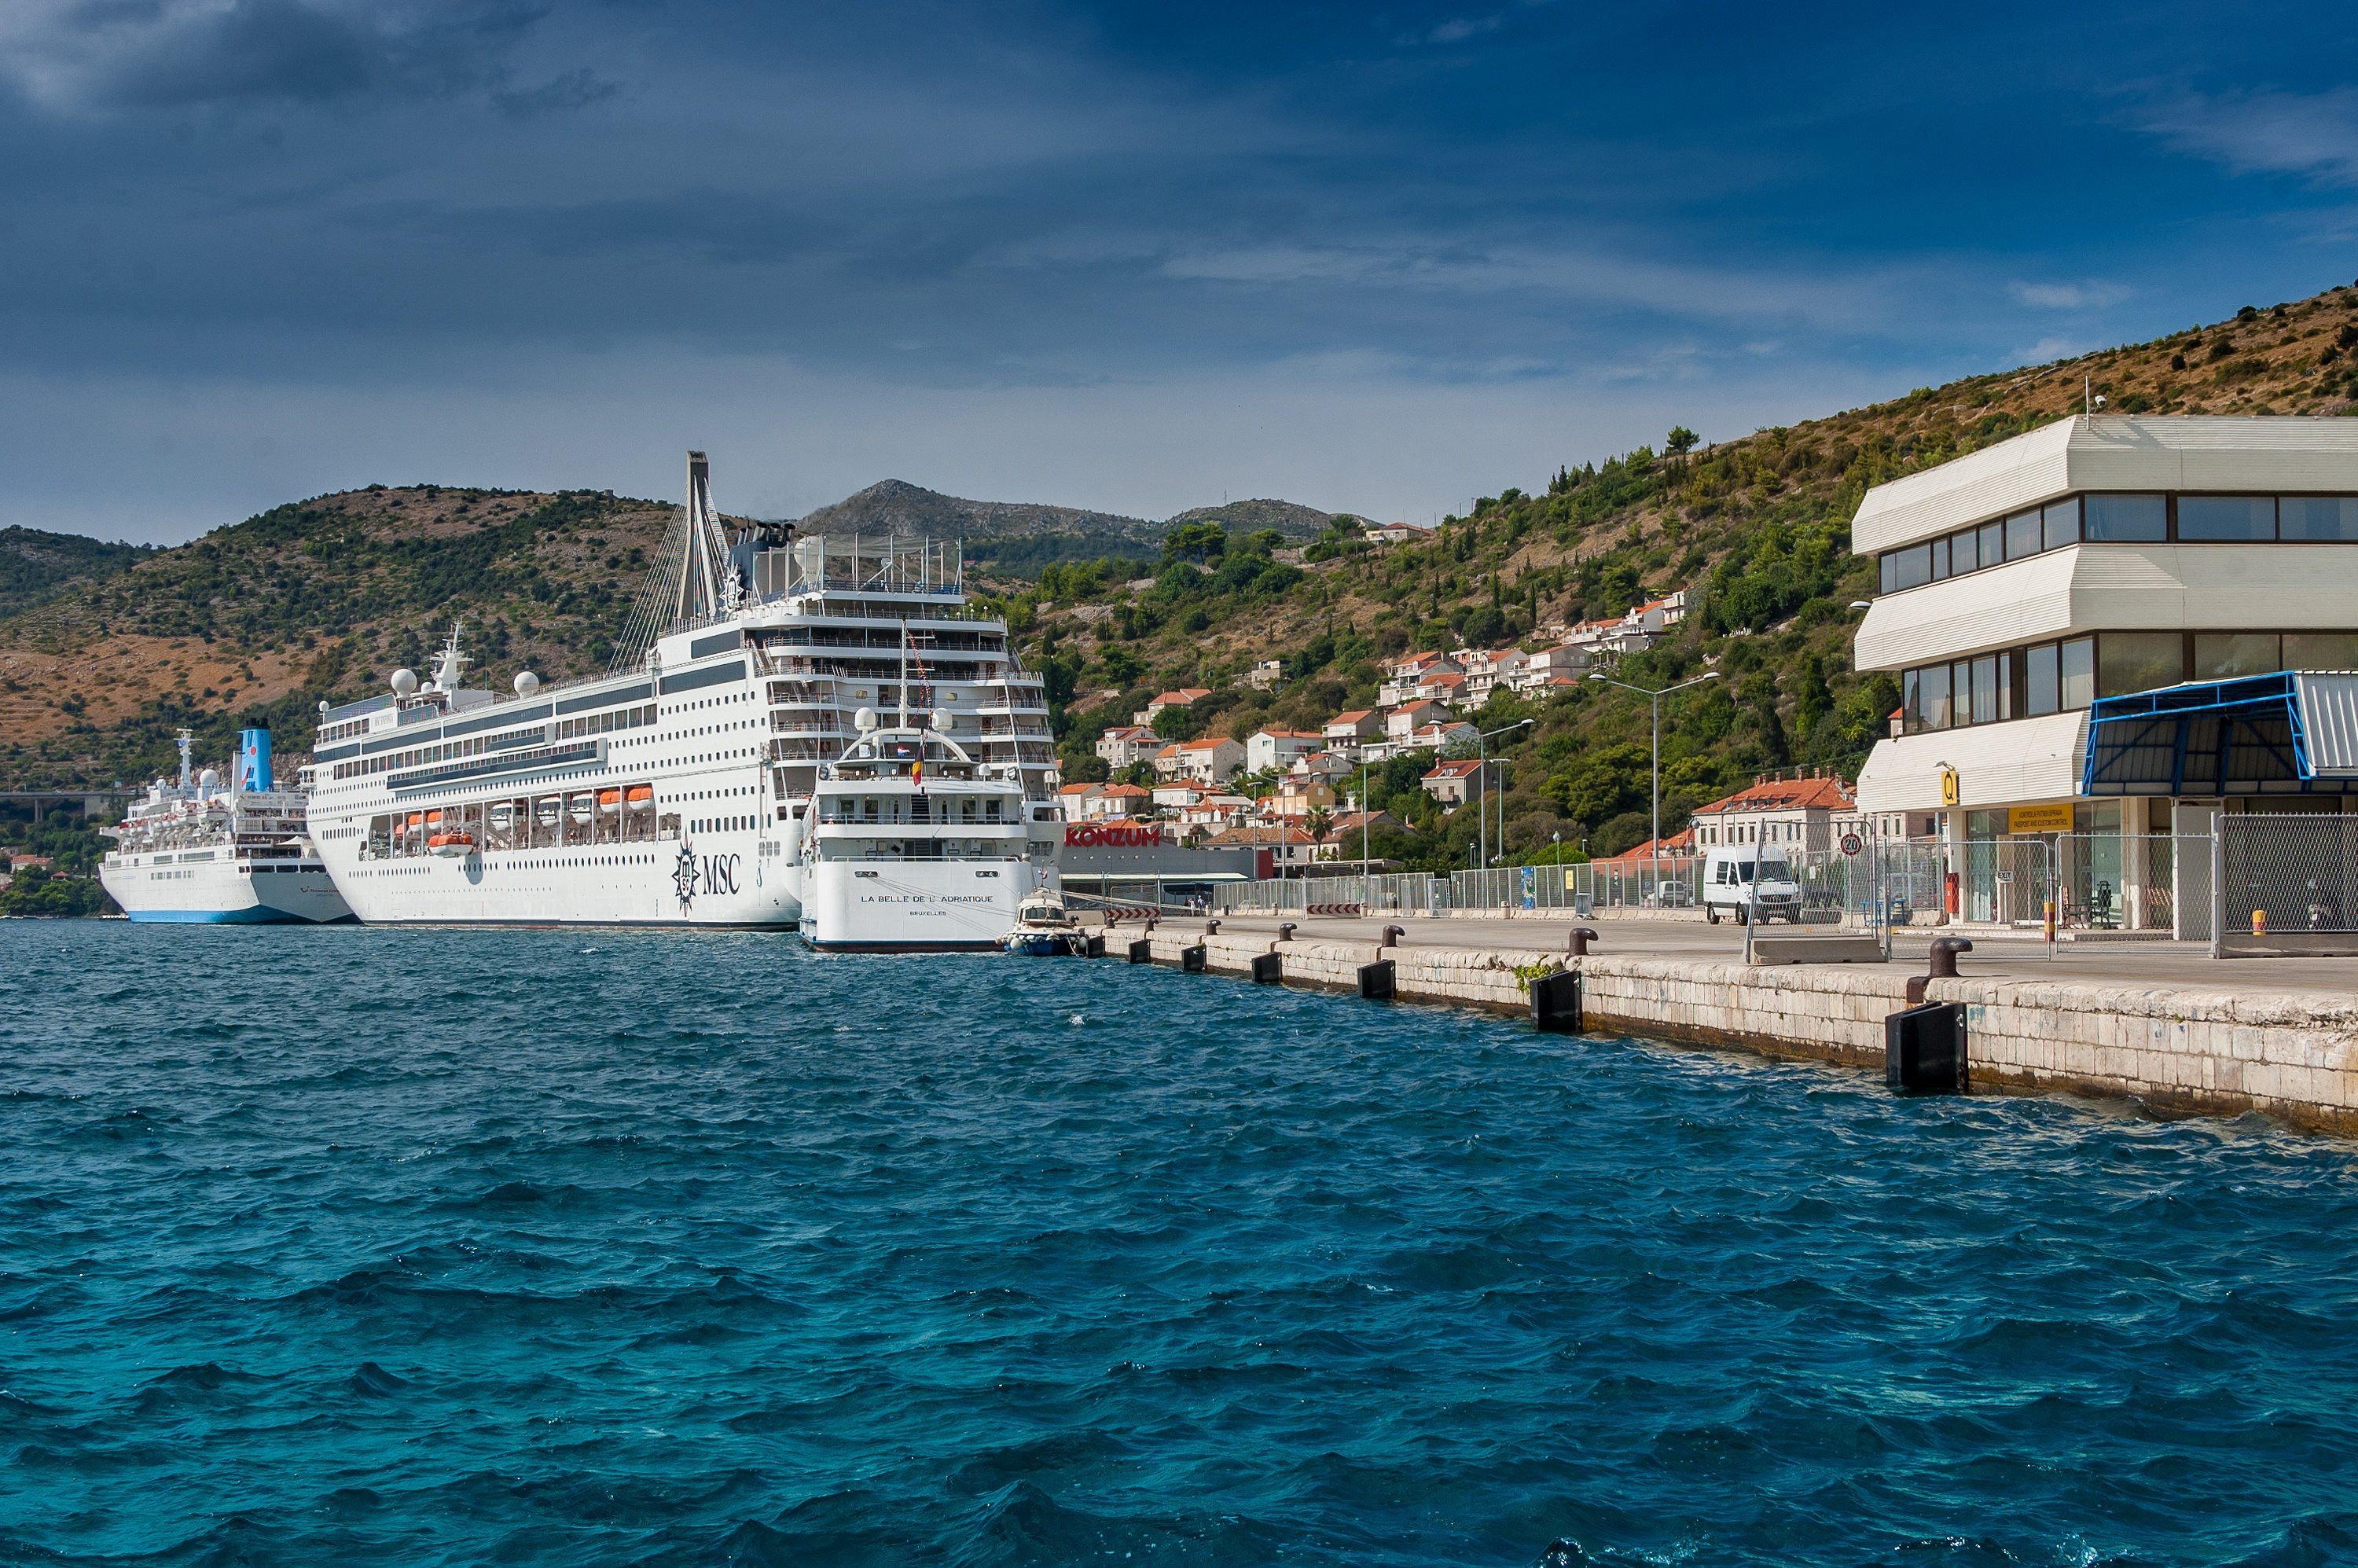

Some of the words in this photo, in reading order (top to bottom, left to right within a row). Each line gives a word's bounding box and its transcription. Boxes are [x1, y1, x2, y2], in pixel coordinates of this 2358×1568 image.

[1945, 772, 1954, 801] Q
[1065, 828, 1160, 847] KONZUM
[1845, 839, 1857, 850] 20
[703, 854, 740, 894] MSC
